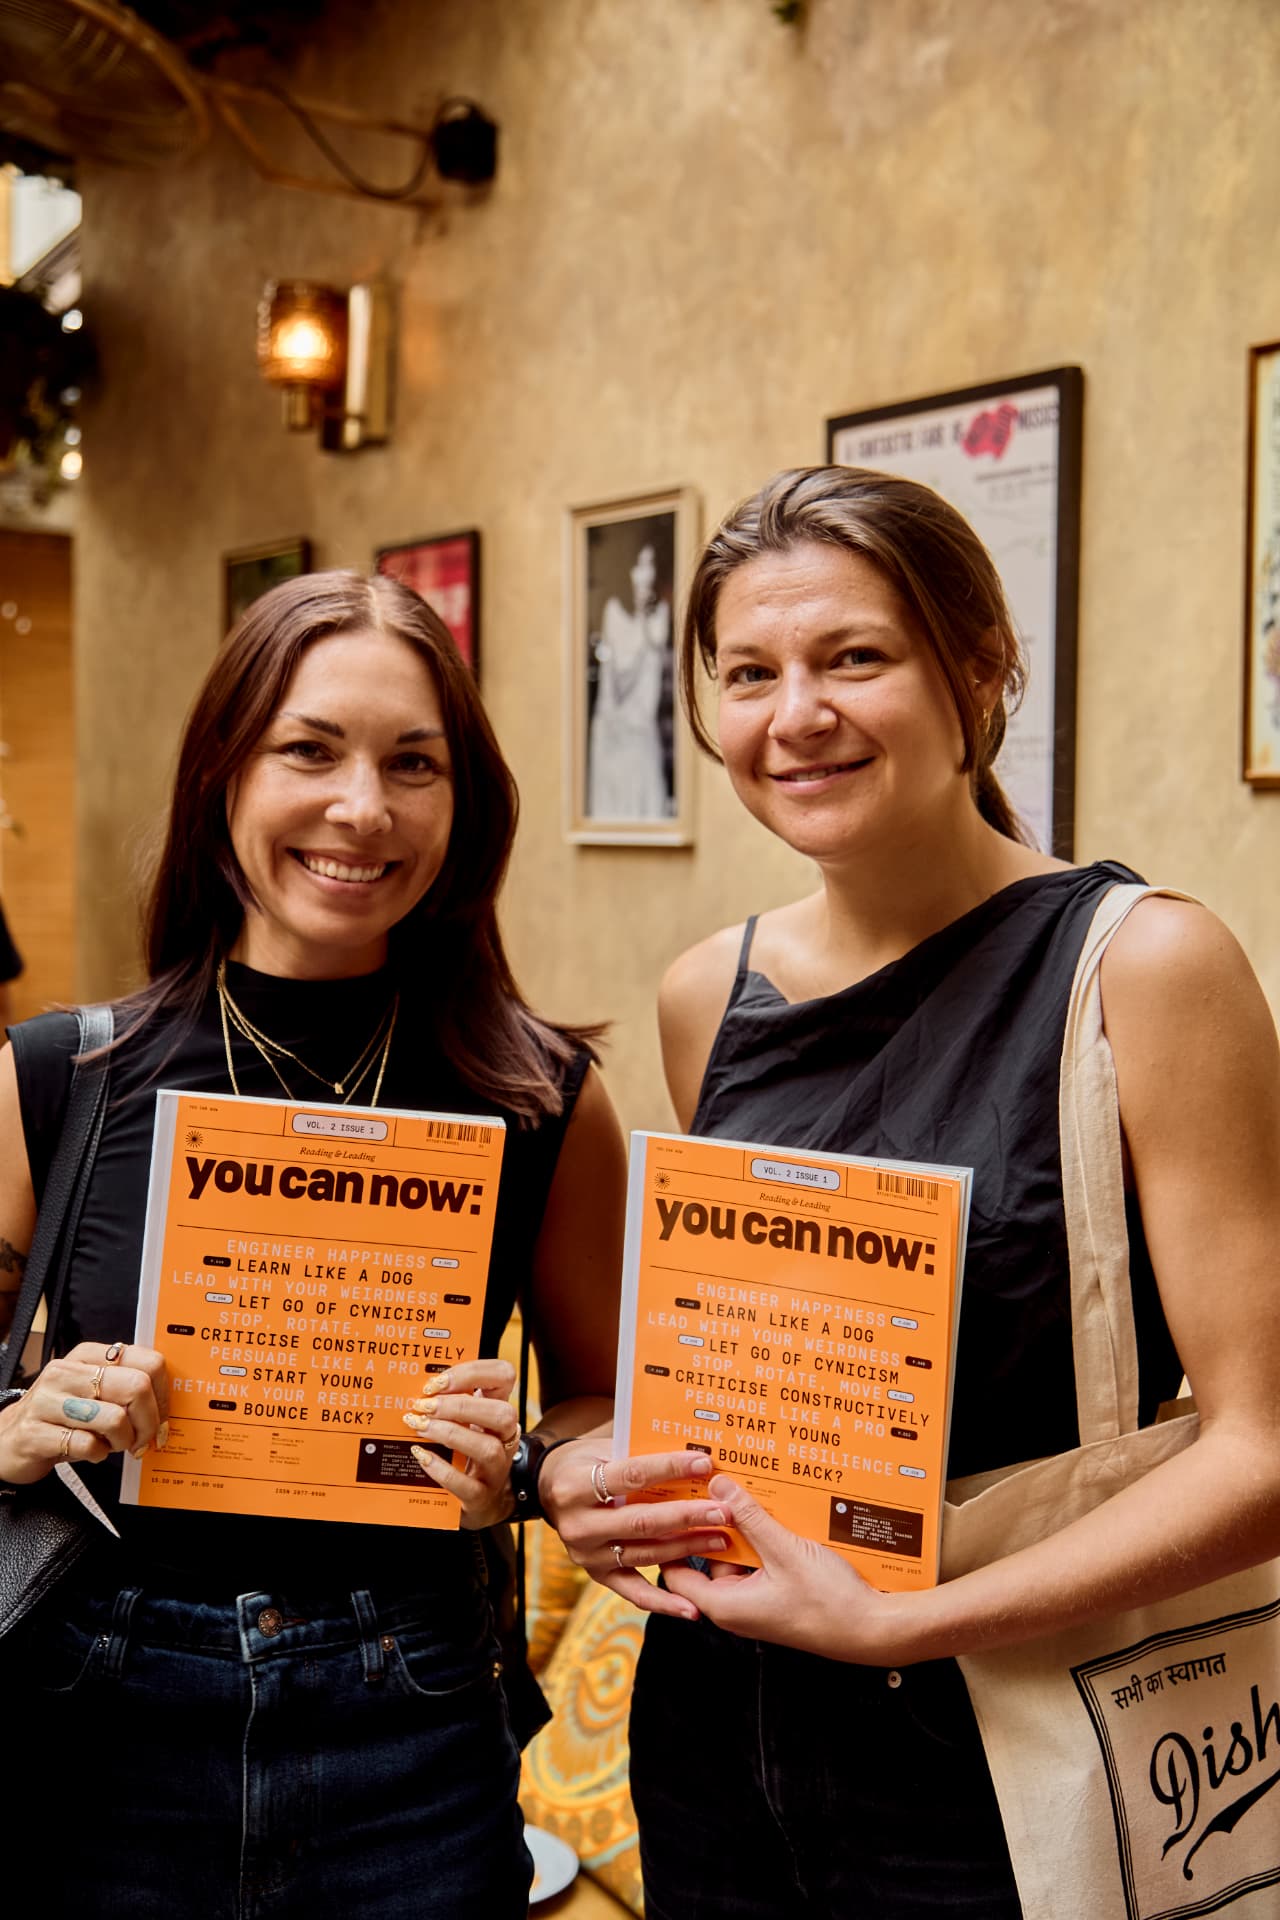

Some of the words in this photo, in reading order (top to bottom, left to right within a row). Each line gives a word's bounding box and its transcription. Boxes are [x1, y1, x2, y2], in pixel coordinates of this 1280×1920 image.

[306, 1120, 325, 1131] VOL.
[330, 1122, 337, 1132] 2
[340, 1123, 364, 1134] ISSUE
[369, 1125, 375, 1135] 1
[300, 1146, 333, 1161] Reading
[333, 1150, 343, 1160] &
[343, 1151, 375, 1163] Leading
[185, 1156, 273, 1199] you
[279, 1165, 364, 1203] can
[370, 1173, 484, 1215] now:
[764, 1166, 782, 1176] VOL.
[786, 1169, 792, 1178] 2
[795, 1171, 819, 1182] ISSUE
[822, 1174, 828, 1184] 1
[759, 1192, 790, 1207] Reading
[790, 1197, 799, 1206] &
[799, 1199, 831, 1213] Leading
[655, 1198, 736, 1241] you
[742, 1211, 820, 1254] can
[827, 1226, 935, 1275] now:
[227, 1239, 314, 1260] ENGINEER
[328, 1248, 426, 1269] HAPPINESS
[173, 1270, 215, 1288] LEAD
[228, 1275, 271, 1292] WITH
[285, 1279, 327, 1297] YOUR
[340, 1285, 438, 1306] WEIRDNESS
[237, 1259, 291, 1276] LEARN
[305, 1265, 346, 1281] LIKE
[359, 1269, 368, 1282] A
[381, 1270, 413, 1286] DOG
[238, 1295, 270, 1311] LET
[282, 1299, 303, 1314] GO
[316, 1302, 337, 1316] OF
[350, 1304, 436, 1323] CYNICISM
[697, 1282, 779, 1308] ENGINEER
[791, 1299, 886, 1327] HAPPINESS
[218, 1311, 270, 1329] STOP,
[287, 1317, 358, 1336] ROTATE,
[375, 1325, 417, 1340] MOVE
[648, 1311, 687, 1329] LEAD
[700, 1319, 740, 1338] WITH
[752, 1327, 792, 1347] YOUR
[804, 1337, 900, 1366] WEIRDNESS
[706, 1301, 756, 1322] LEARN
[769, 1312, 809, 1332] LIKE
[821, 1322, 830, 1335] A
[843, 1325, 874, 1343] DOG
[200, 1327, 300, 1348] CRITICISE
[312, 1337, 465, 1360] CONSTRUCTIVELY
[210, 1346, 298, 1367] PERSUADE
[311, 1355, 354, 1371] LIKE
[365, 1358, 374, 1372] A
[388, 1360, 419, 1376] PRO
[692, 1354, 740, 1376] STOP,
[755, 1365, 825, 1391] ROTATE,
[840, 1380, 881, 1400] MOVE
[709, 1340, 738, 1356] LET
[751, 1347, 770, 1361] GO
[782, 1351, 802, 1366] OF
[814, 1357, 899, 1385] CYNICISM
[173, 1378, 249, 1398] RETHINK
[263, 1386, 305, 1402] YOUR
[318, 1391, 414, 1411] RESILIENC
[253, 1368, 306, 1386] START
[320, 1373, 373, 1390] YOUNG
[244, 1402, 308, 1421] BOUNCE
[321, 1409, 374, 1425] BACK?
[675, 1369, 768, 1397] CRITICISE
[780, 1387, 930, 1428] CONSTRUCTIVELY
[685, 1389, 767, 1416] PERSUADE
[780, 1405, 820, 1425] LIKE
[832, 1415, 841, 1429] A
[854, 1419, 886, 1438] PRO
[651, 1418, 723, 1444] RETHINK
[735, 1434, 776, 1453] YOUR
[788, 1444, 893, 1476] RESILIENCE
[725, 1413, 776, 1434] START
[789, 1426, 840, 1447] YOUNG
[718, 1448, 780, 1472] BOUNCE
[792, 1462, 843, 1484] BACK?
[1111, 1674, 1144, 1709] सभी
[1144, 1670, 1165, 1695] का
[1164, 1653, 1227, 1686] स्वागत
